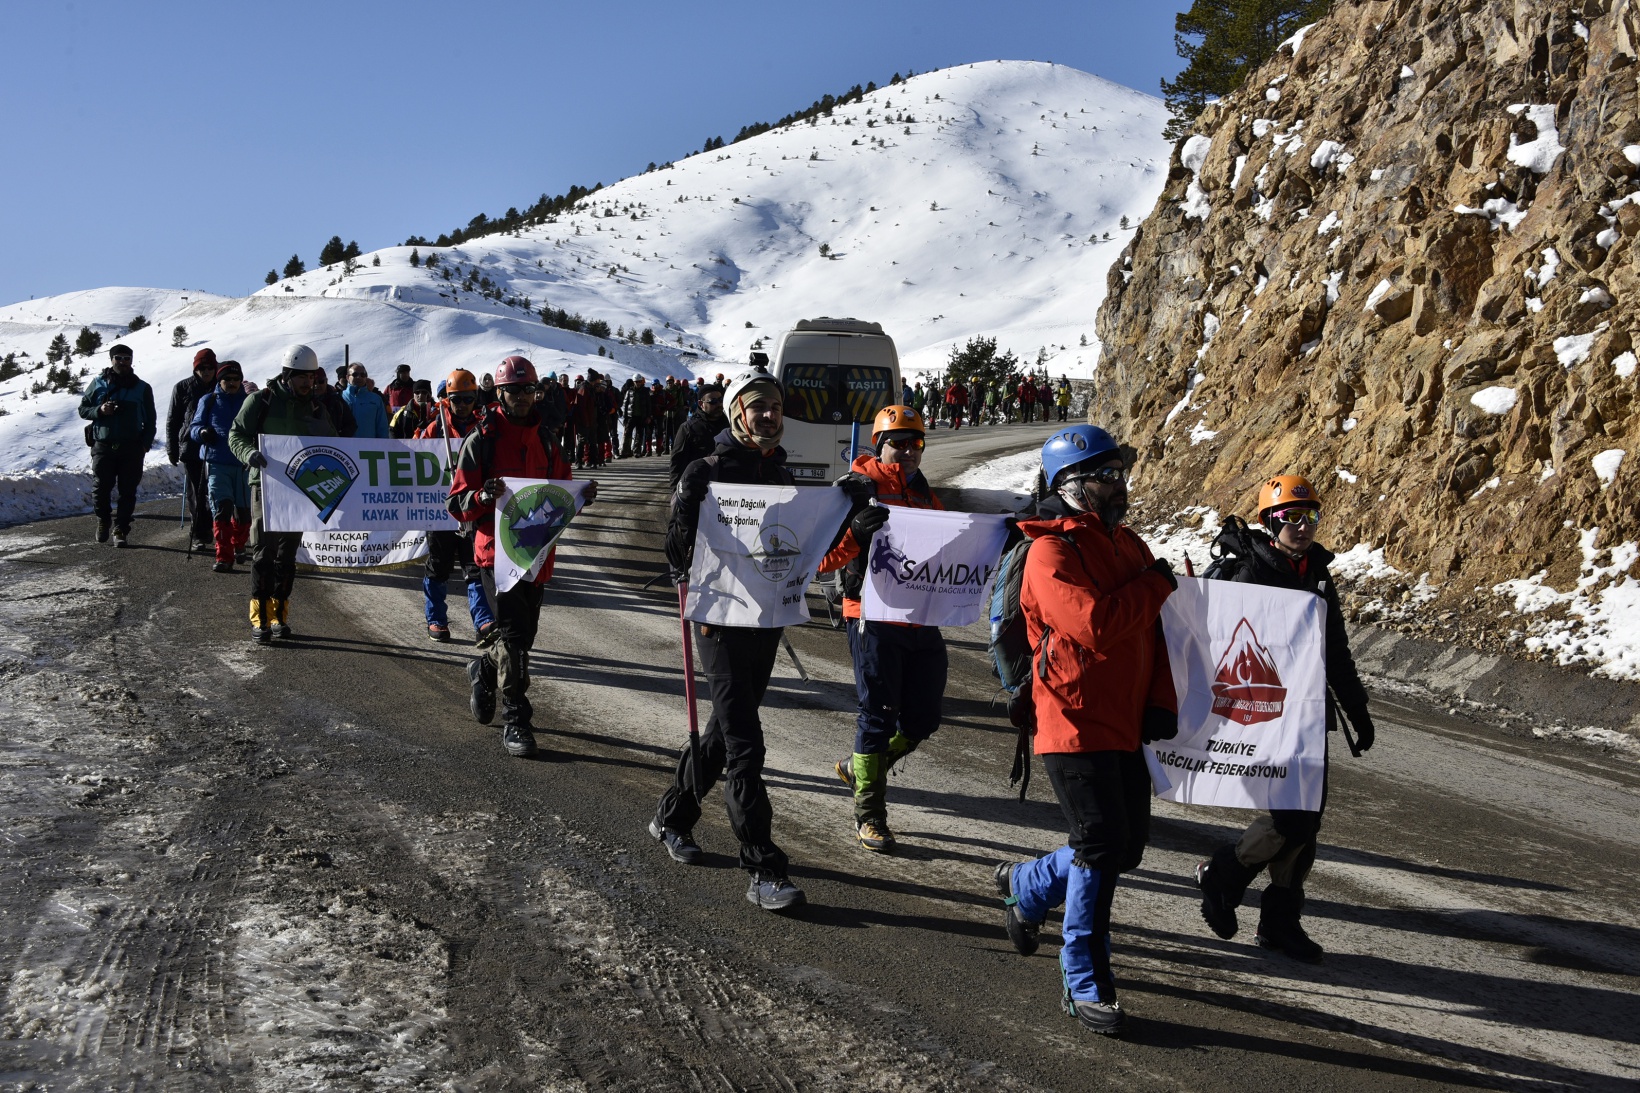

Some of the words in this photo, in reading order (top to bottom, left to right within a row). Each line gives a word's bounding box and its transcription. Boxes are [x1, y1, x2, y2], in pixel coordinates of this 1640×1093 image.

[793, 379, 825, 388] OKUL
[849, 381, 886, 391] TAŞITI
[800, 469, 804, 477] S
[305, 474, 345, 500] TEDAK
[361, 492, 414, 504] TRABZON
[416, 489, 447, 504] TENİS
[740, 498, 767, 511] Dağcılık
[362, 509, 399, 521] KAYAK
[406, 507, 449, 521] İHTİSAS
[717, 513, 733, 526] Doğa
[329, 532, 369, 543] KAÇKAR
[315, 542, 358, 553] RAFTİNG
[360, 542, 389, 552] KAYAK
[391, 536, 425, 550] İHTİSAS
[315, 554, 342, 564] SPOR
[905, 582, 937, 593] SAMSUN
[1205, 739, 1256, 756] TÜRKİYE
[1209, 761, 1287, 779] FEDERASYONU
